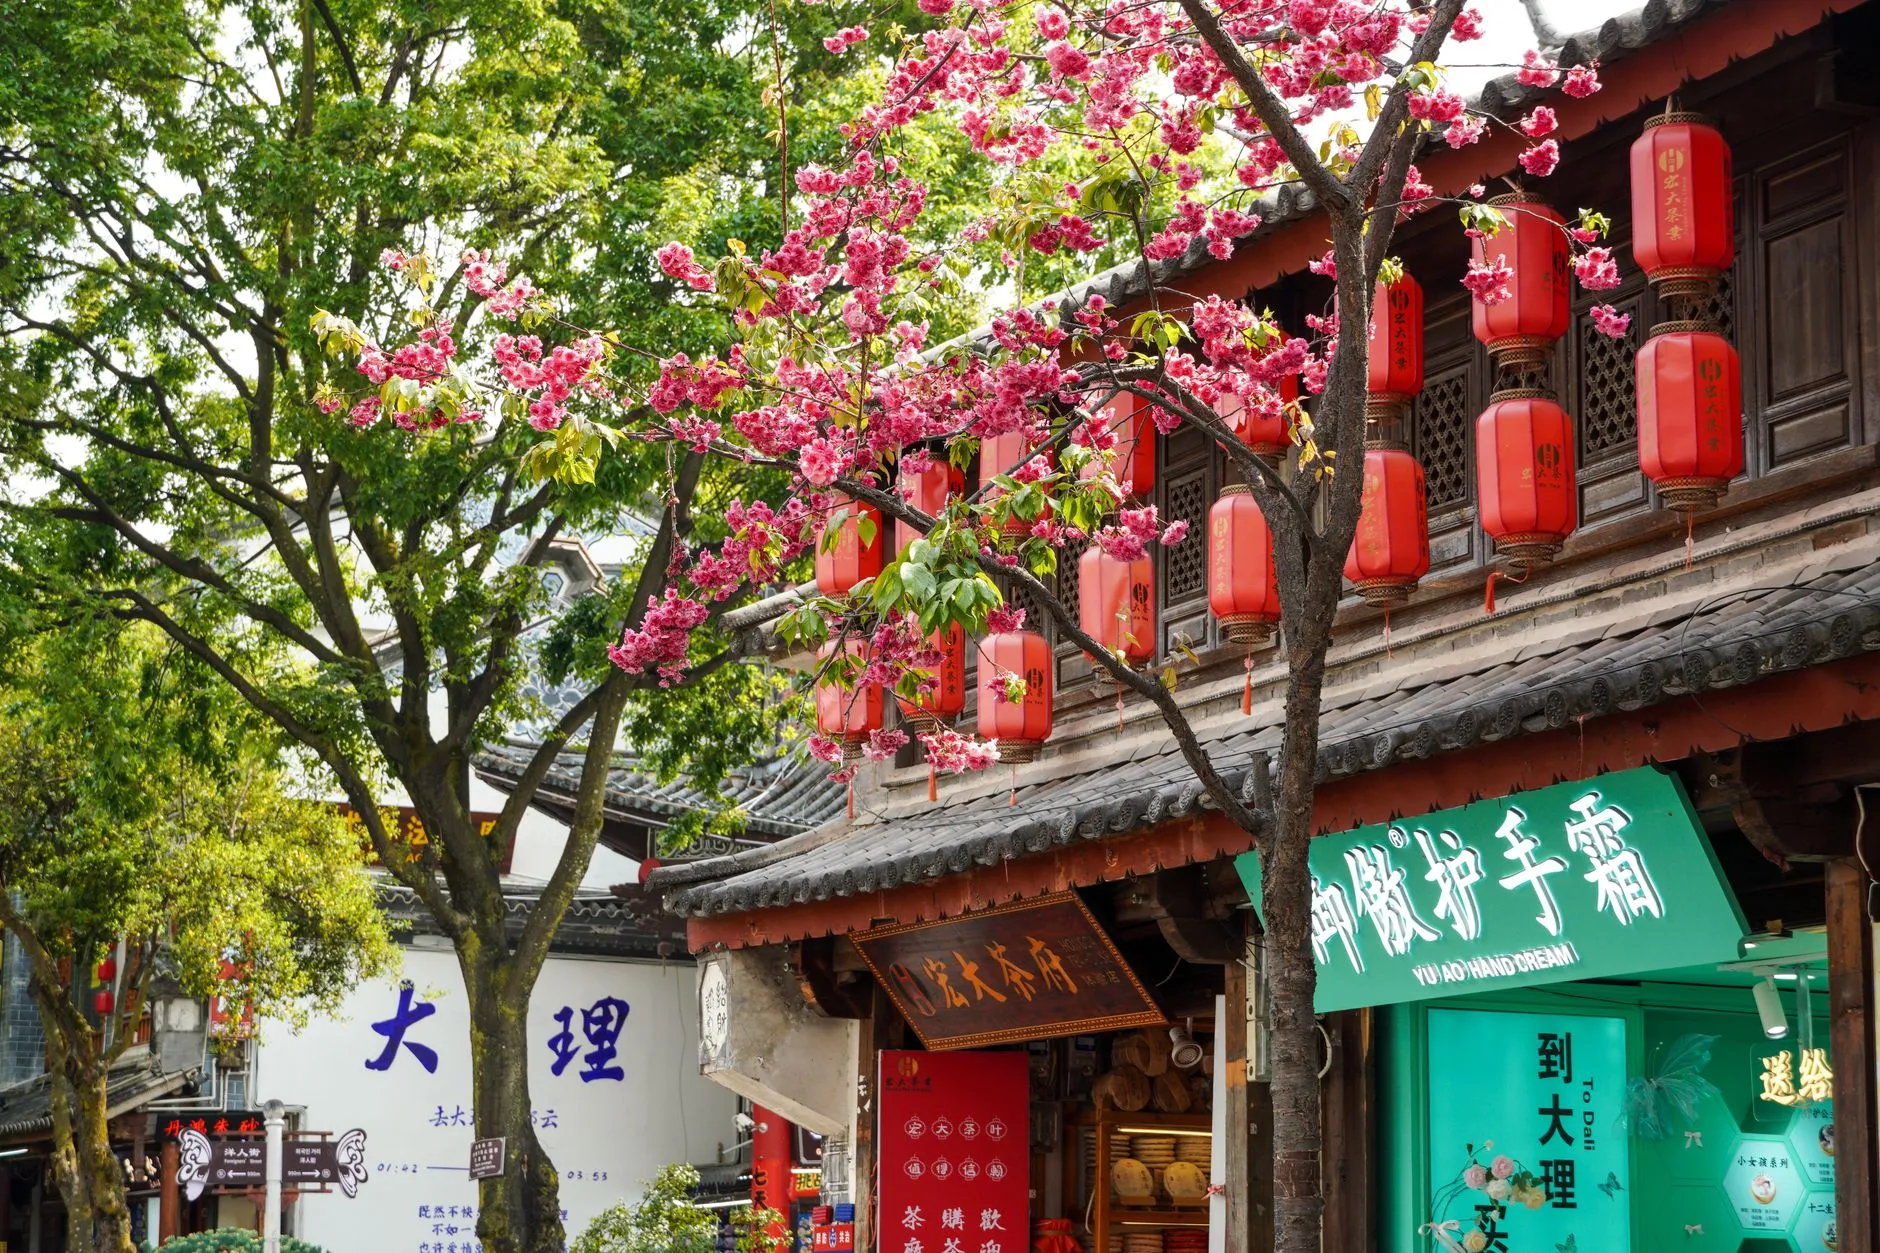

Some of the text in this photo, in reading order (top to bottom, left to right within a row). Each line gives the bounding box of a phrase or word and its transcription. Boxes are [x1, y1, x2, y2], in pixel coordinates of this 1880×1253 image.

[1412, 941, 1578, 986] YU AO HAND CREAM
[1537, 1032, 1577, 1208] 到大理
[1582, 1077, 1595, 1151] To Dali
[1737, 1156, 1789, 1169] 小女孩系列
